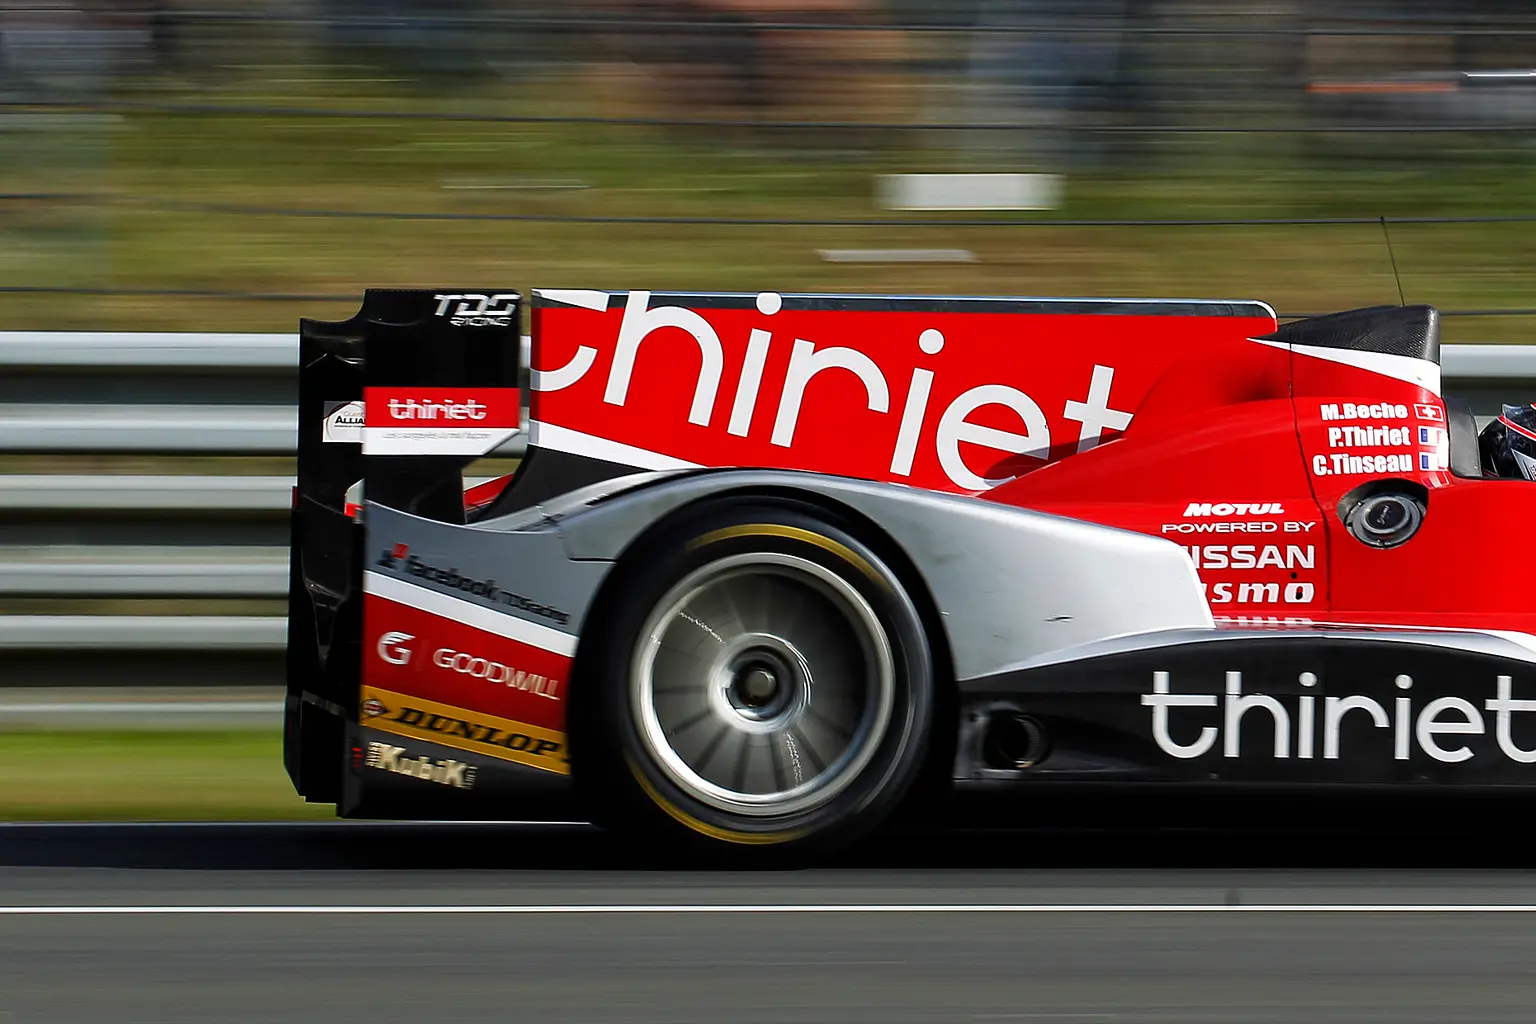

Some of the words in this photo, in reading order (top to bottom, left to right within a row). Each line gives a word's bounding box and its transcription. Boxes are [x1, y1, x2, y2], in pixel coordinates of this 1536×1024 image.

[388, 398, 488, 420] thiriet
[1320, 402, 1408, 420] M.Beche
[1328, 425, 1411, 447] P.Thiriet
[1312, 453, 1413, 476] C.Tinseau
[1183, 503, 1285, 517] MOTUL
[1161, 522, 1278, 533] POWERED
[1283, 521, 1316, 532] BY
[1182, 545, 1315, 569] ISSAN
[432, 647, 561, 701] GOODWILL
[394, 707, 564, 757] DUNLOP
